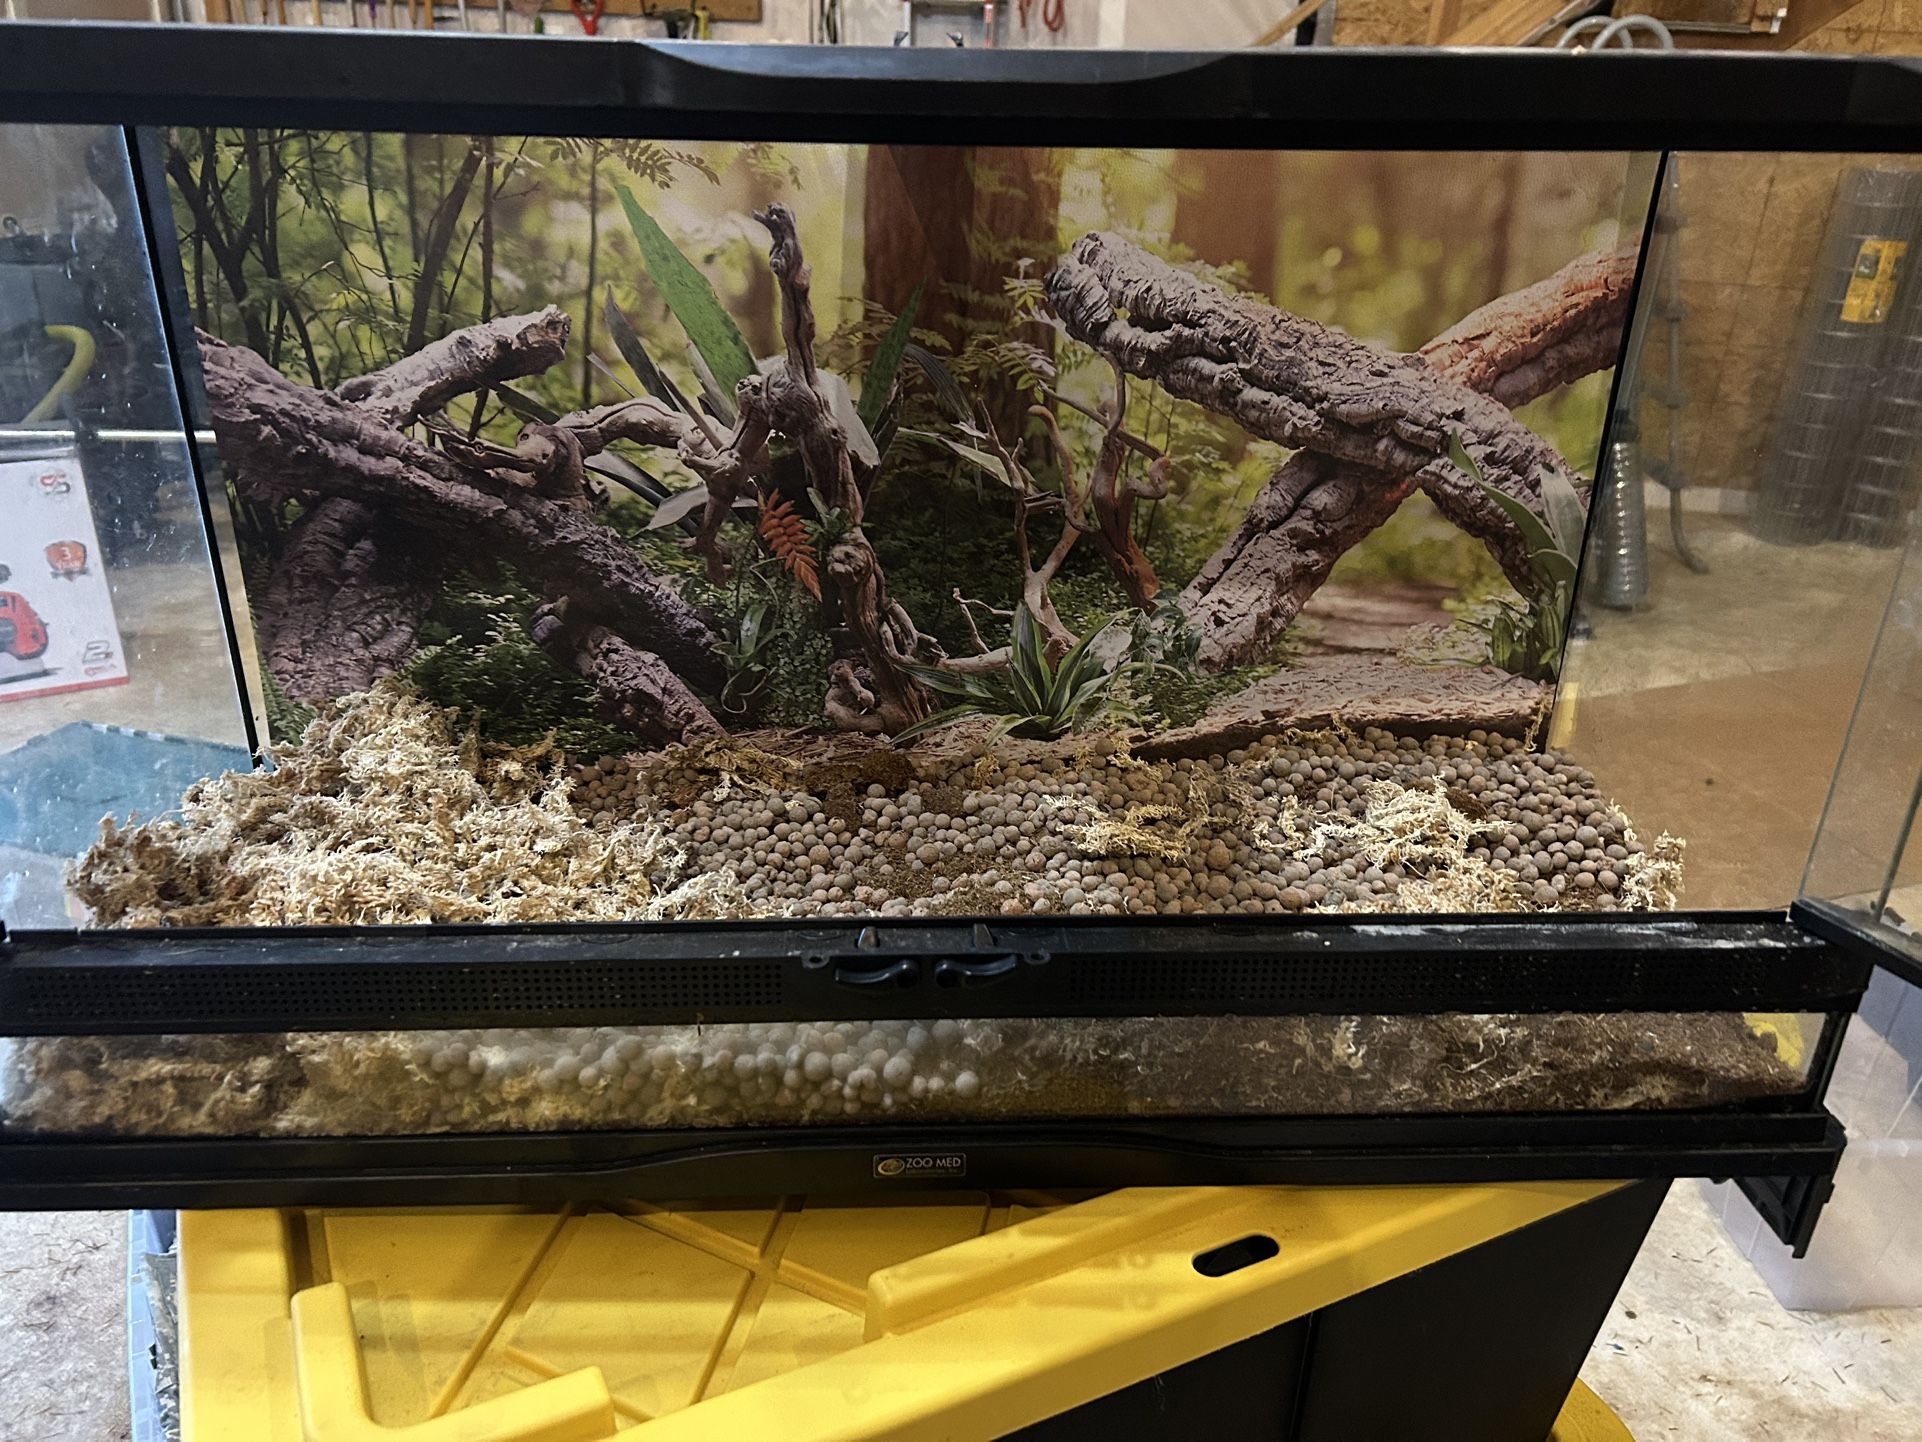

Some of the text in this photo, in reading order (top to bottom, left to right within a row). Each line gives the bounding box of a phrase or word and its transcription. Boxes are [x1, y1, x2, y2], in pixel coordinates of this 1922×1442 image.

[60, 546, 72, 560] 3
[906, 1157, 961, 1168] ZOO MED
